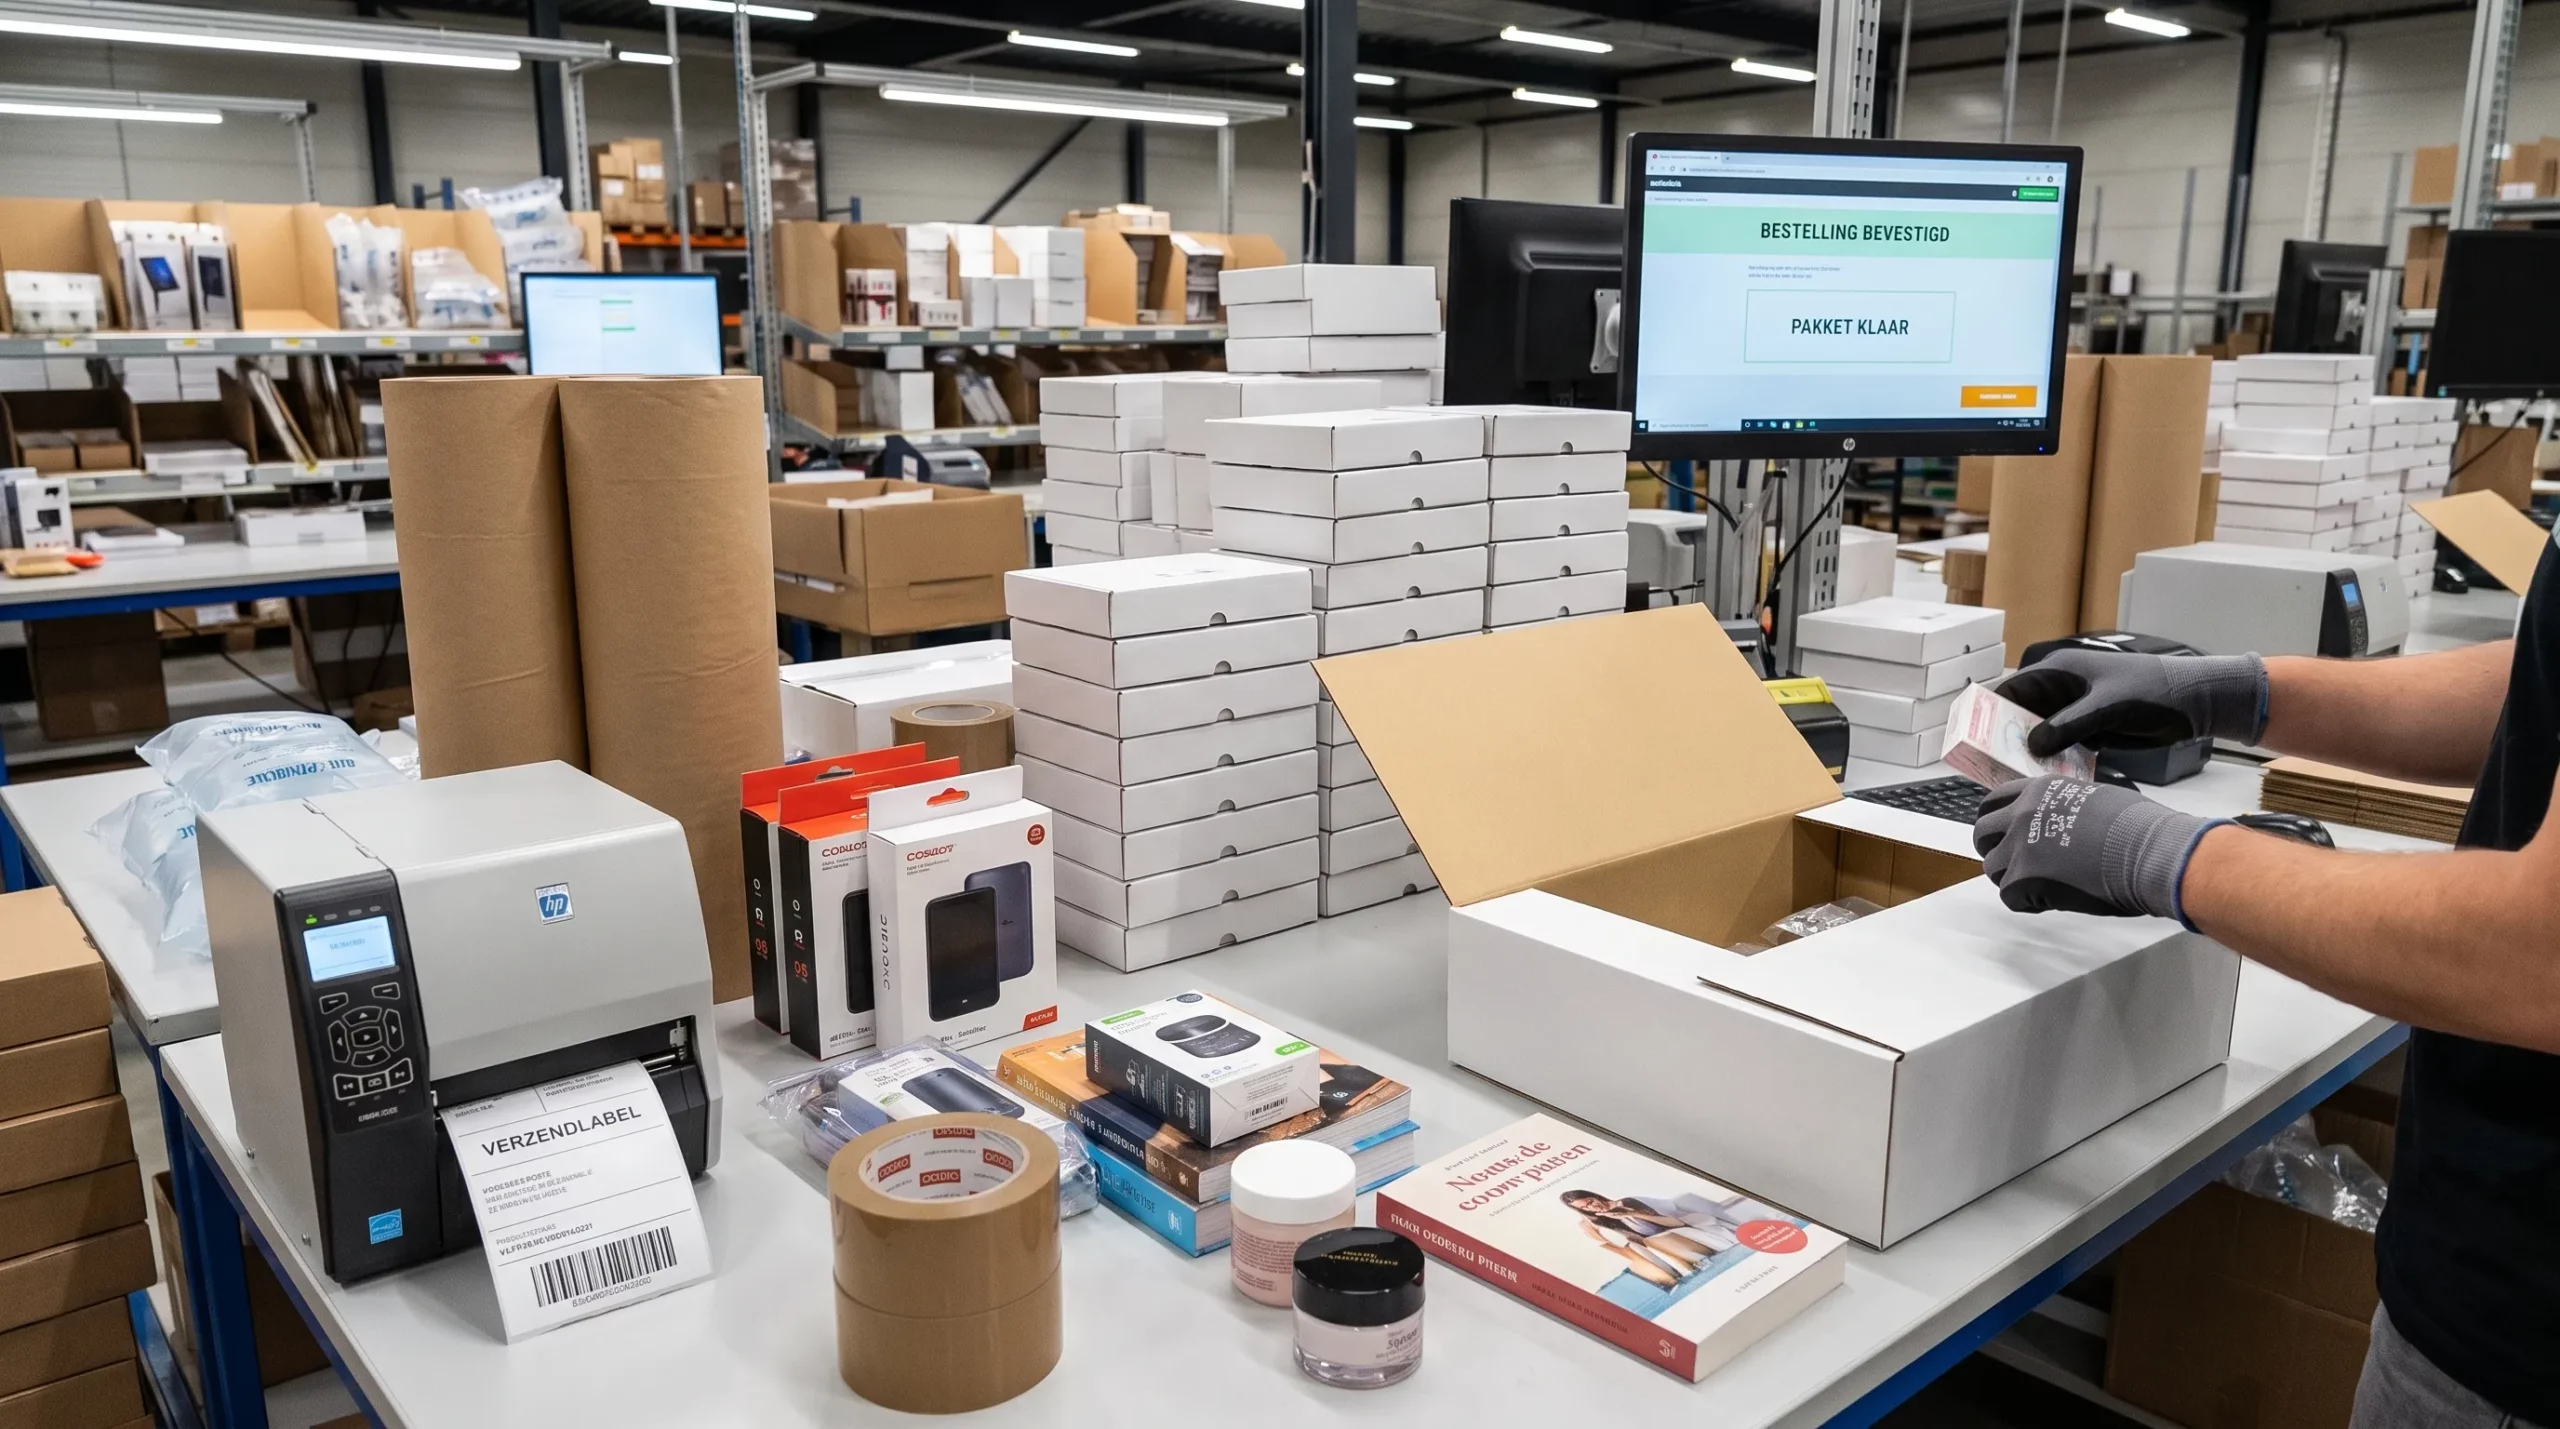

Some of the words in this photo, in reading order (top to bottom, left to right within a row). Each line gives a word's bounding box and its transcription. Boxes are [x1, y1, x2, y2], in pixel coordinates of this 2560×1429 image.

[1761, 222, 1858, 240] BESTELLING
[1863, 225, 1950, 242] BEVESTIGD
[1792, 318, 1853, 335] PAKKET
[1857, 319, 1909, 335] KLAAR
[481, 1106, 641, 1156] VERZENDLABEL
